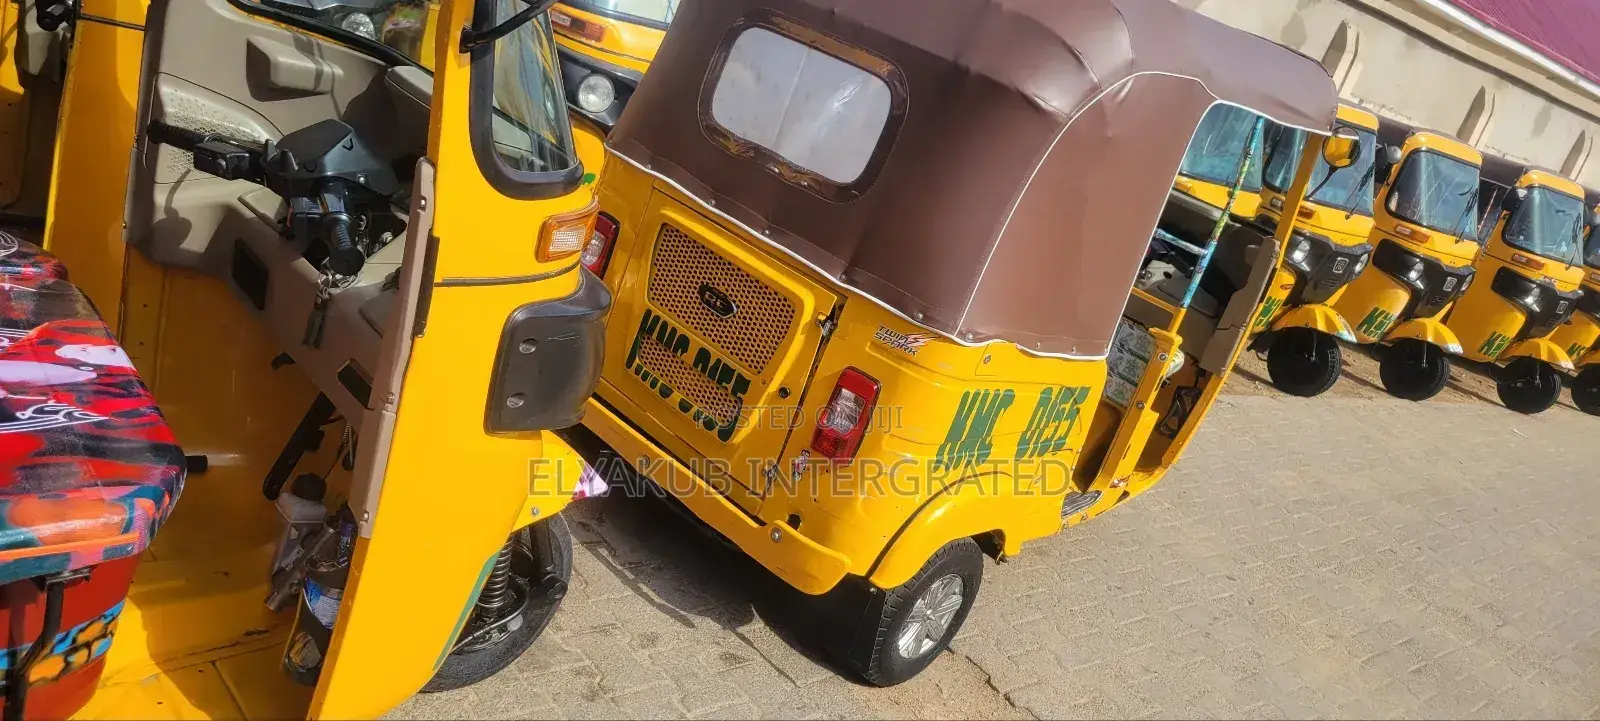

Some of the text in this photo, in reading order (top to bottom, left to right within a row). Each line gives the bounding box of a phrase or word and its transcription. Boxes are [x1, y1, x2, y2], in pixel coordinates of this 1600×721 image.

[873, 332, 919, 357] SPARK
[878, 323, 909, 344] TWIN
[931, 388, 1016, 474] KMC
